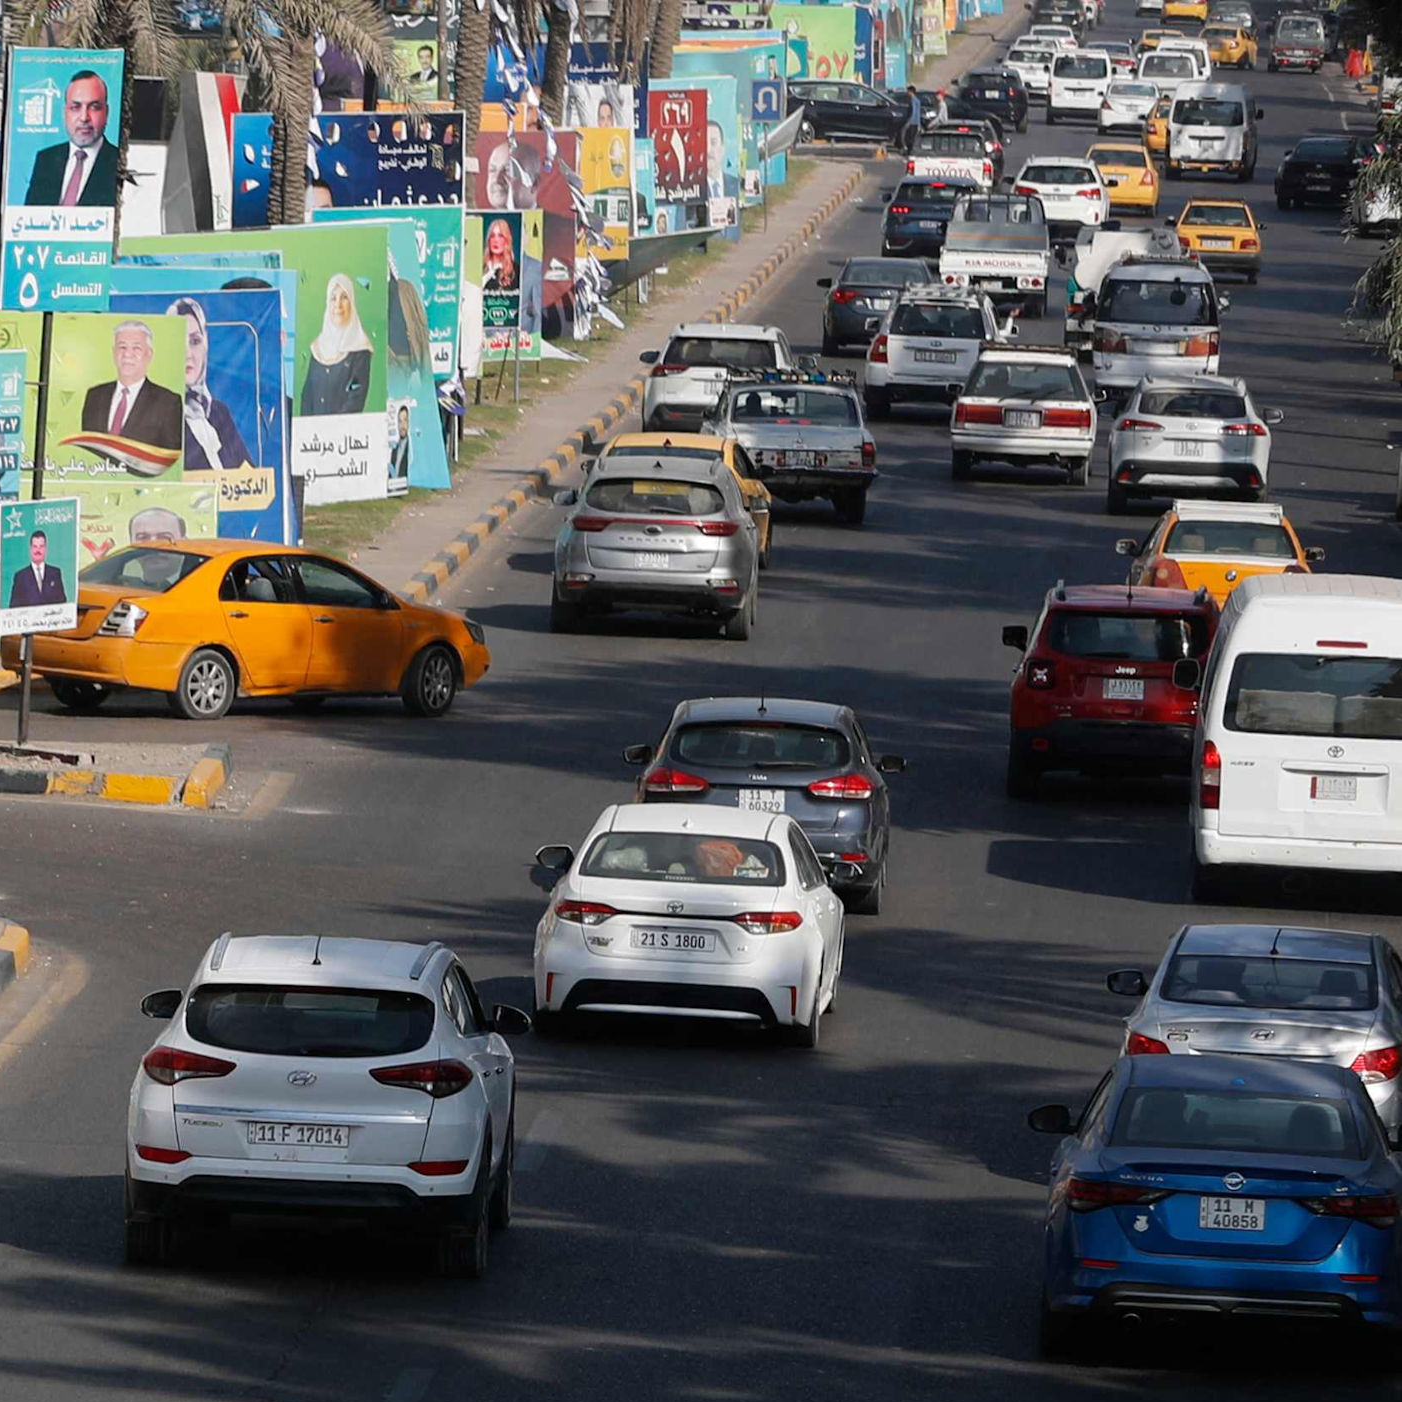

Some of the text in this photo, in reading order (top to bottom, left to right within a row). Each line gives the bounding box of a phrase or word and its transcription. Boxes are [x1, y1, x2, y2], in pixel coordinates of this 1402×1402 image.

[925, 166, 973, 178] TOYOTA
[13, 244, 107, 271] القائمة ٢٠٧
[964, 258, 1023, 268] KIA MOTORS
[18, 271, 102, 308] التسلسل ٥
[299, 436, 369, 456] نهال مرشد
[221, 474, 269, 500] الدكتورة
[1115, 665, 1137, 676] Jeep
[748, 801, 781, 812] 60329
[640, 932, 707, 949] 21 S 1800
[257, 1124, 343, 1145] 11 F 17014
[1213, 1199, 1232, 1213] 11
[1212, 1214, 1259, 1230] 40858
